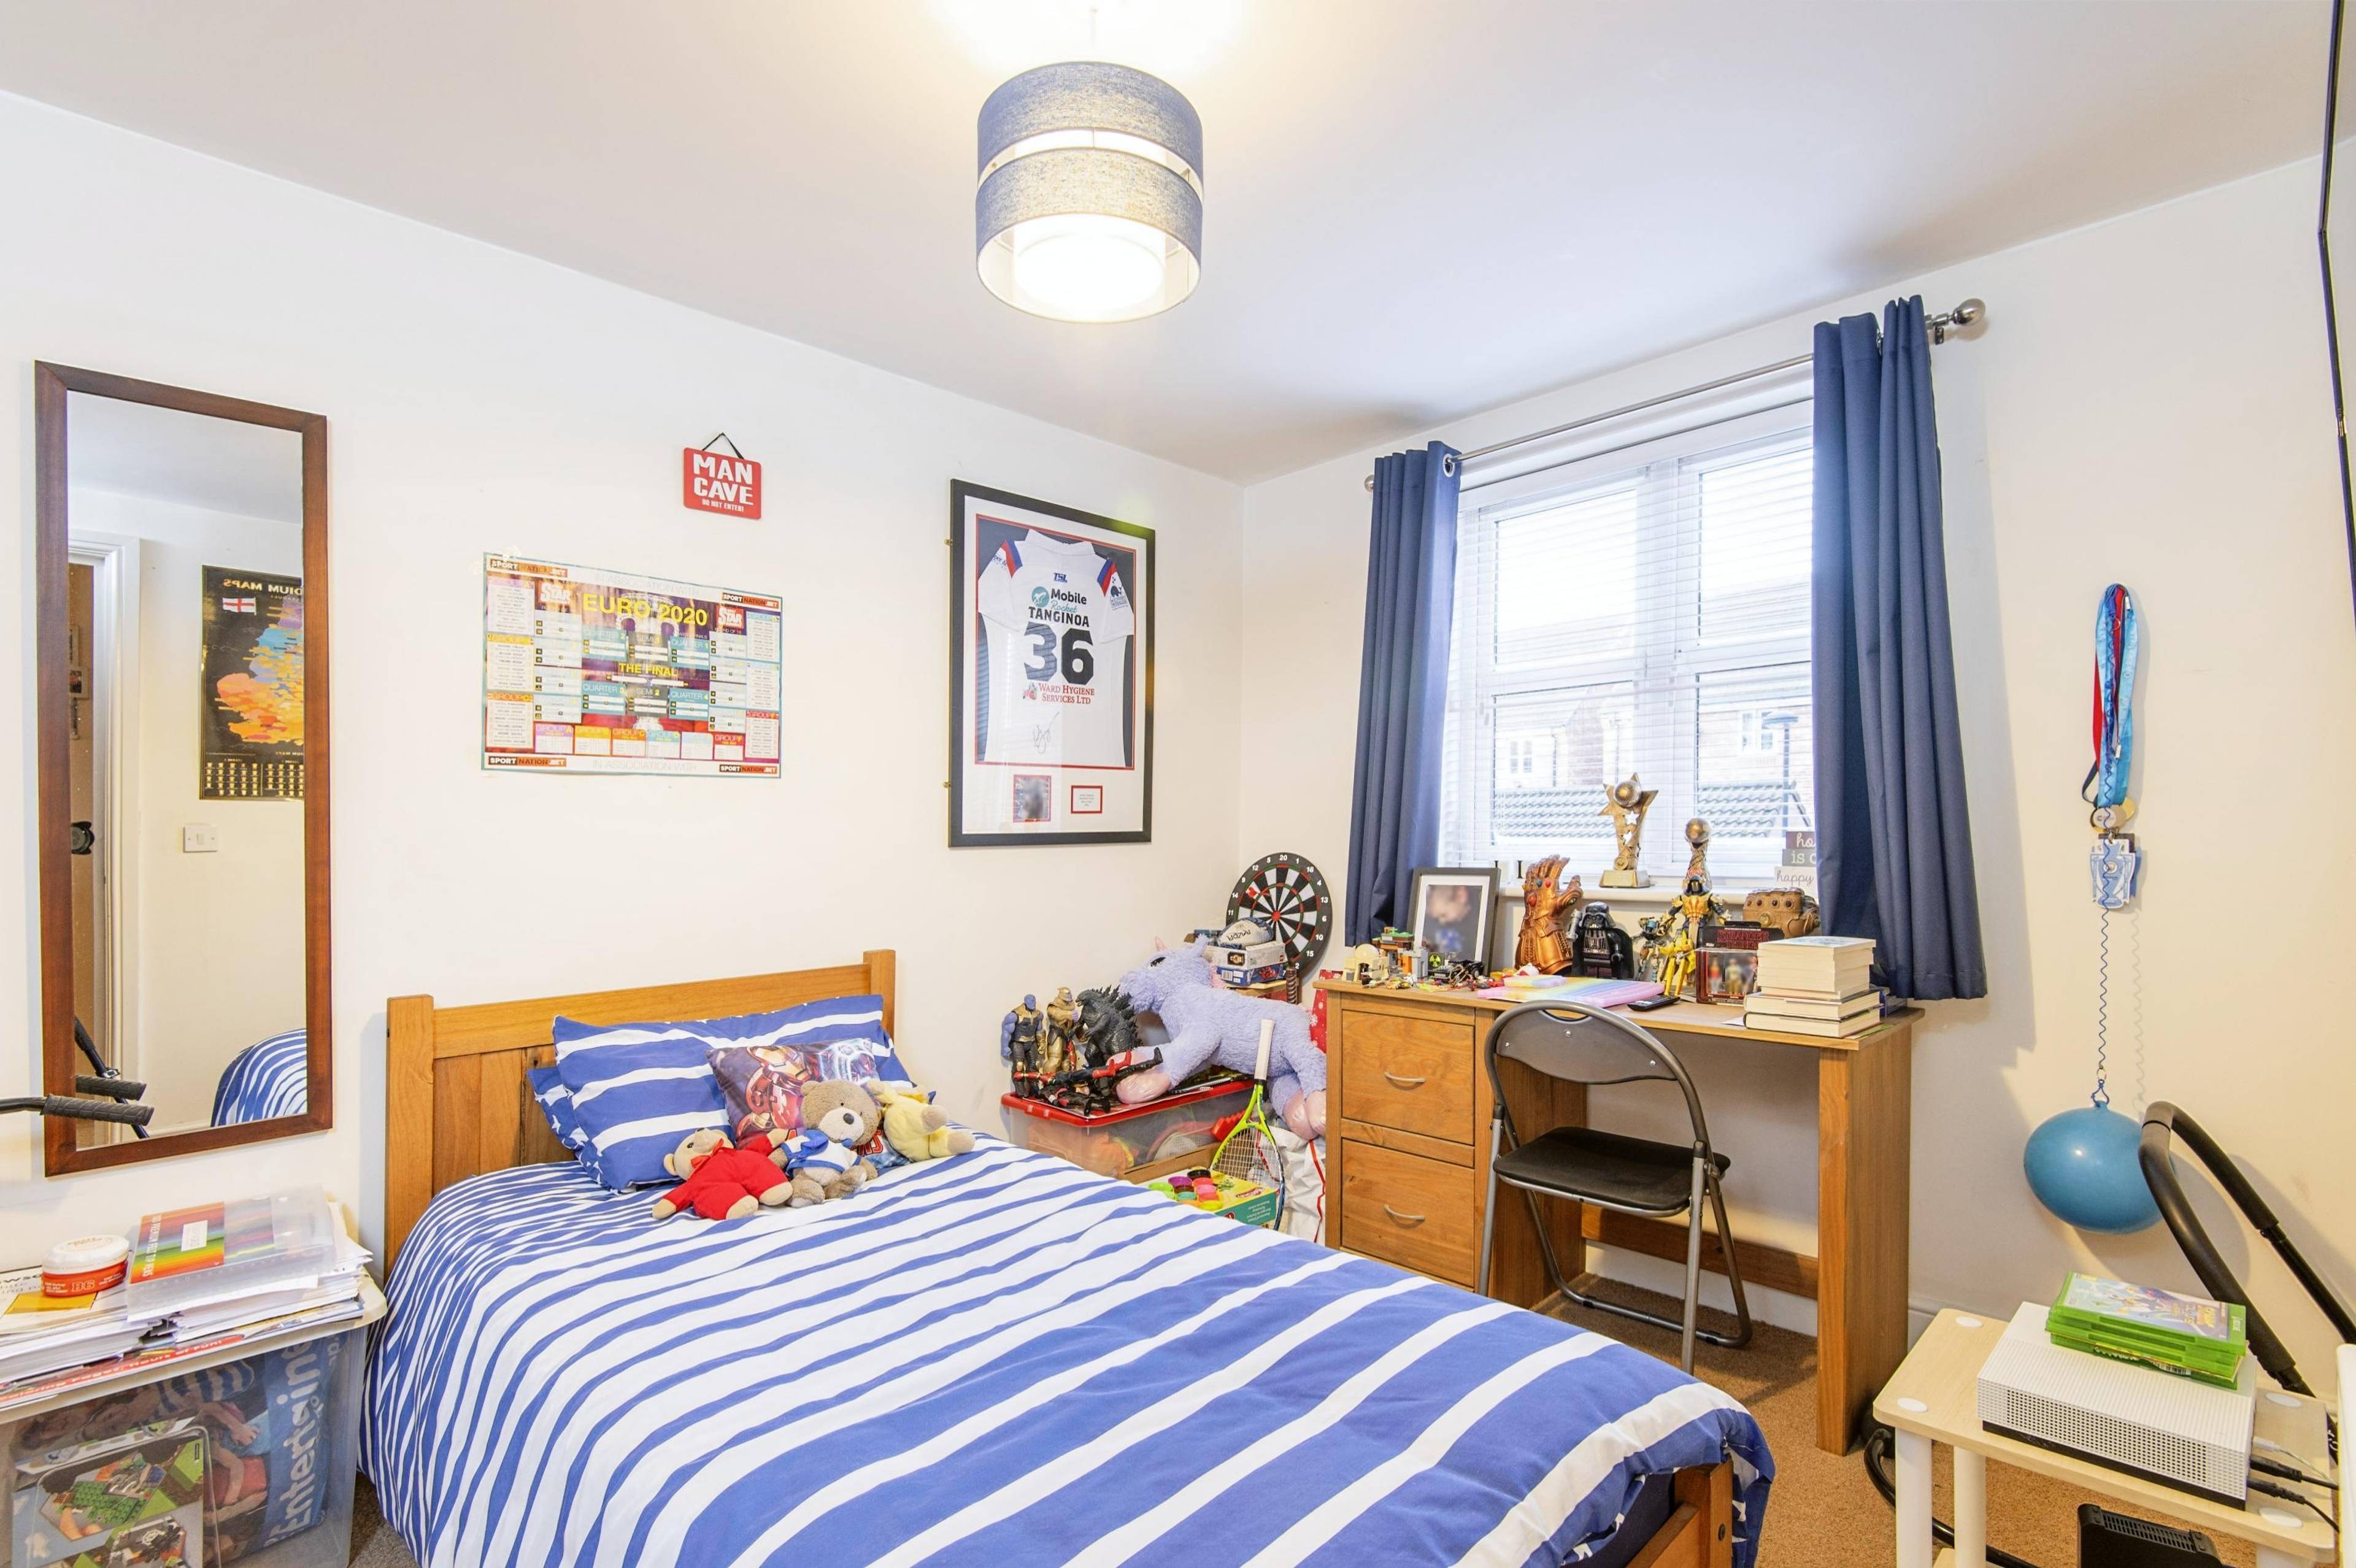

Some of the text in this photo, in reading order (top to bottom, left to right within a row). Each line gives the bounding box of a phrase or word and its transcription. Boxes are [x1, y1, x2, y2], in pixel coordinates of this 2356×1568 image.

[693, 453, 753, 485] MAN
[694, 477, 753, 505] CAVE
[724, 503, 744, 512] ENTER!
[723, 593, 742, 602] SPORT
[1050, 588, 1087, 605] Mobile
[583, 593, 707, 626] EURO 2020
[1050, 600, 1078, 613] Rocket
[1028, 606, 1090, 627] TANGINOA
[1023, 621, 1094, 685] 36
[619, 663, 677, 676] THE FINAL
[583, 684, 617, 693] QUARTER
[671, 691, 703, 699] QUARTER
[1038, 683, 1095, 696] WARD HYGIENE
[1042, 693, 1074, 704] SERVICES
[1792, 851, 1804, 864] is
[1777, 869, 1814, 887] happy
[1226, 929, 1251, 942] RAZOR
[71, 1280, 95, 1293] B6
